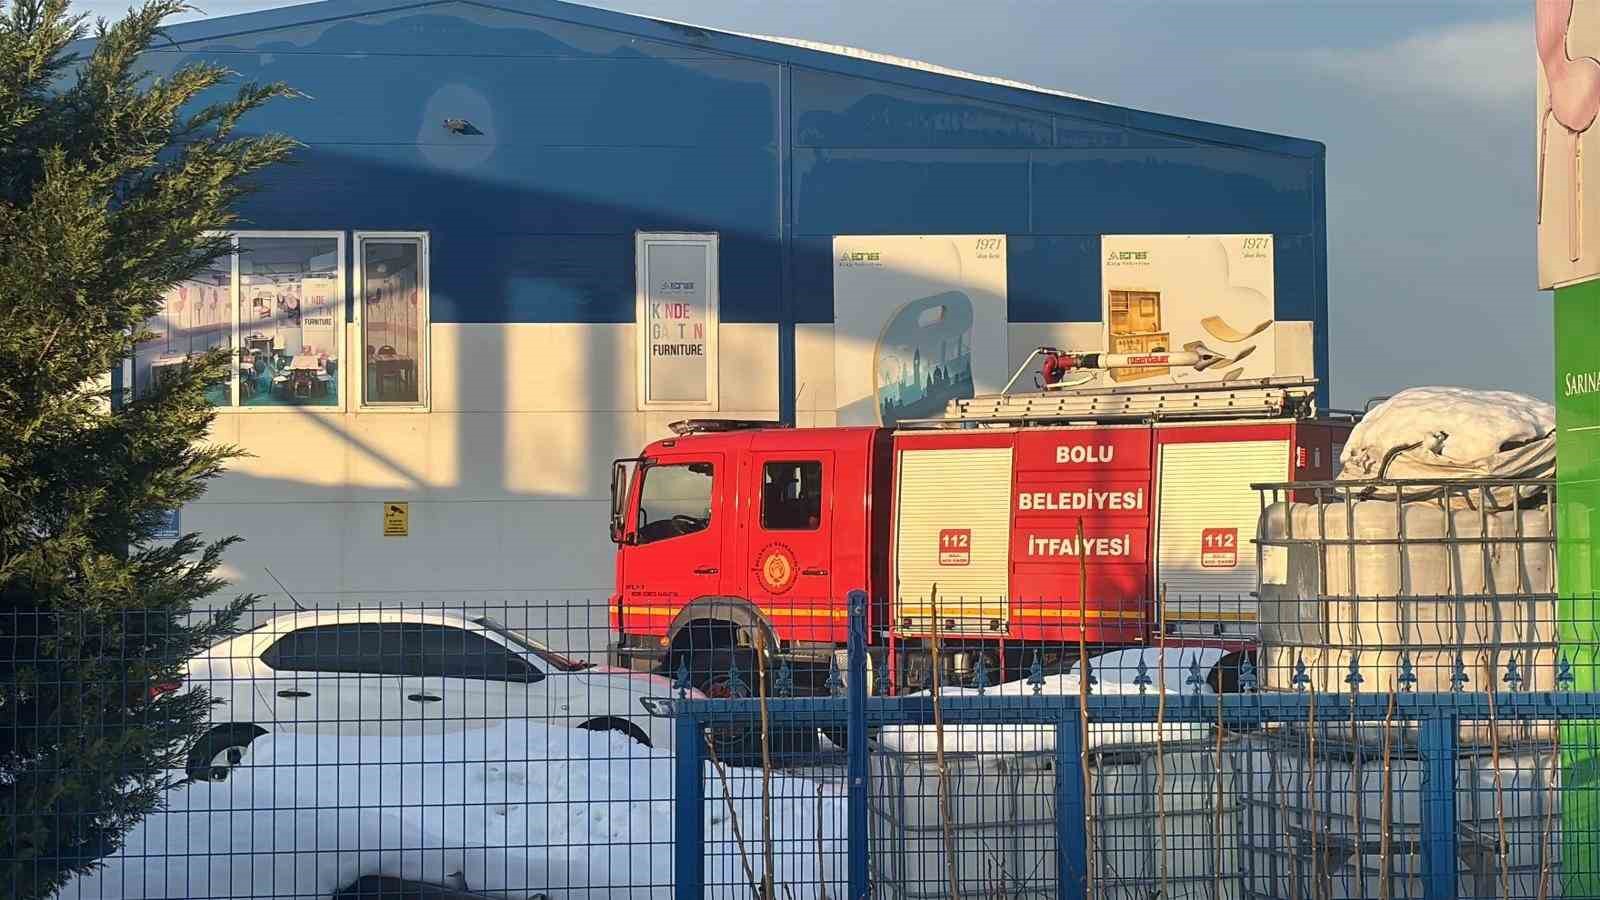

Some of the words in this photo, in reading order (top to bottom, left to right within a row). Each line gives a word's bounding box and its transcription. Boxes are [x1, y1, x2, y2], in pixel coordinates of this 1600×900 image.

[976, 238, 1002, 250] 1971
[1243, 237, 1269, 249] 1971
[304, 318, 332, 326] FURNITURE
[653, 344, 703, 356] FURNITURE
[1056, 445, 1114, 463] BOLU
[1019, 488, 1143, 510] BELEDİYESİ
[942, 534, 968, 548] 112
[1028, 534, 1130, 556] İTFAİYESİ
[1205, 533, 1234, 548] 112
